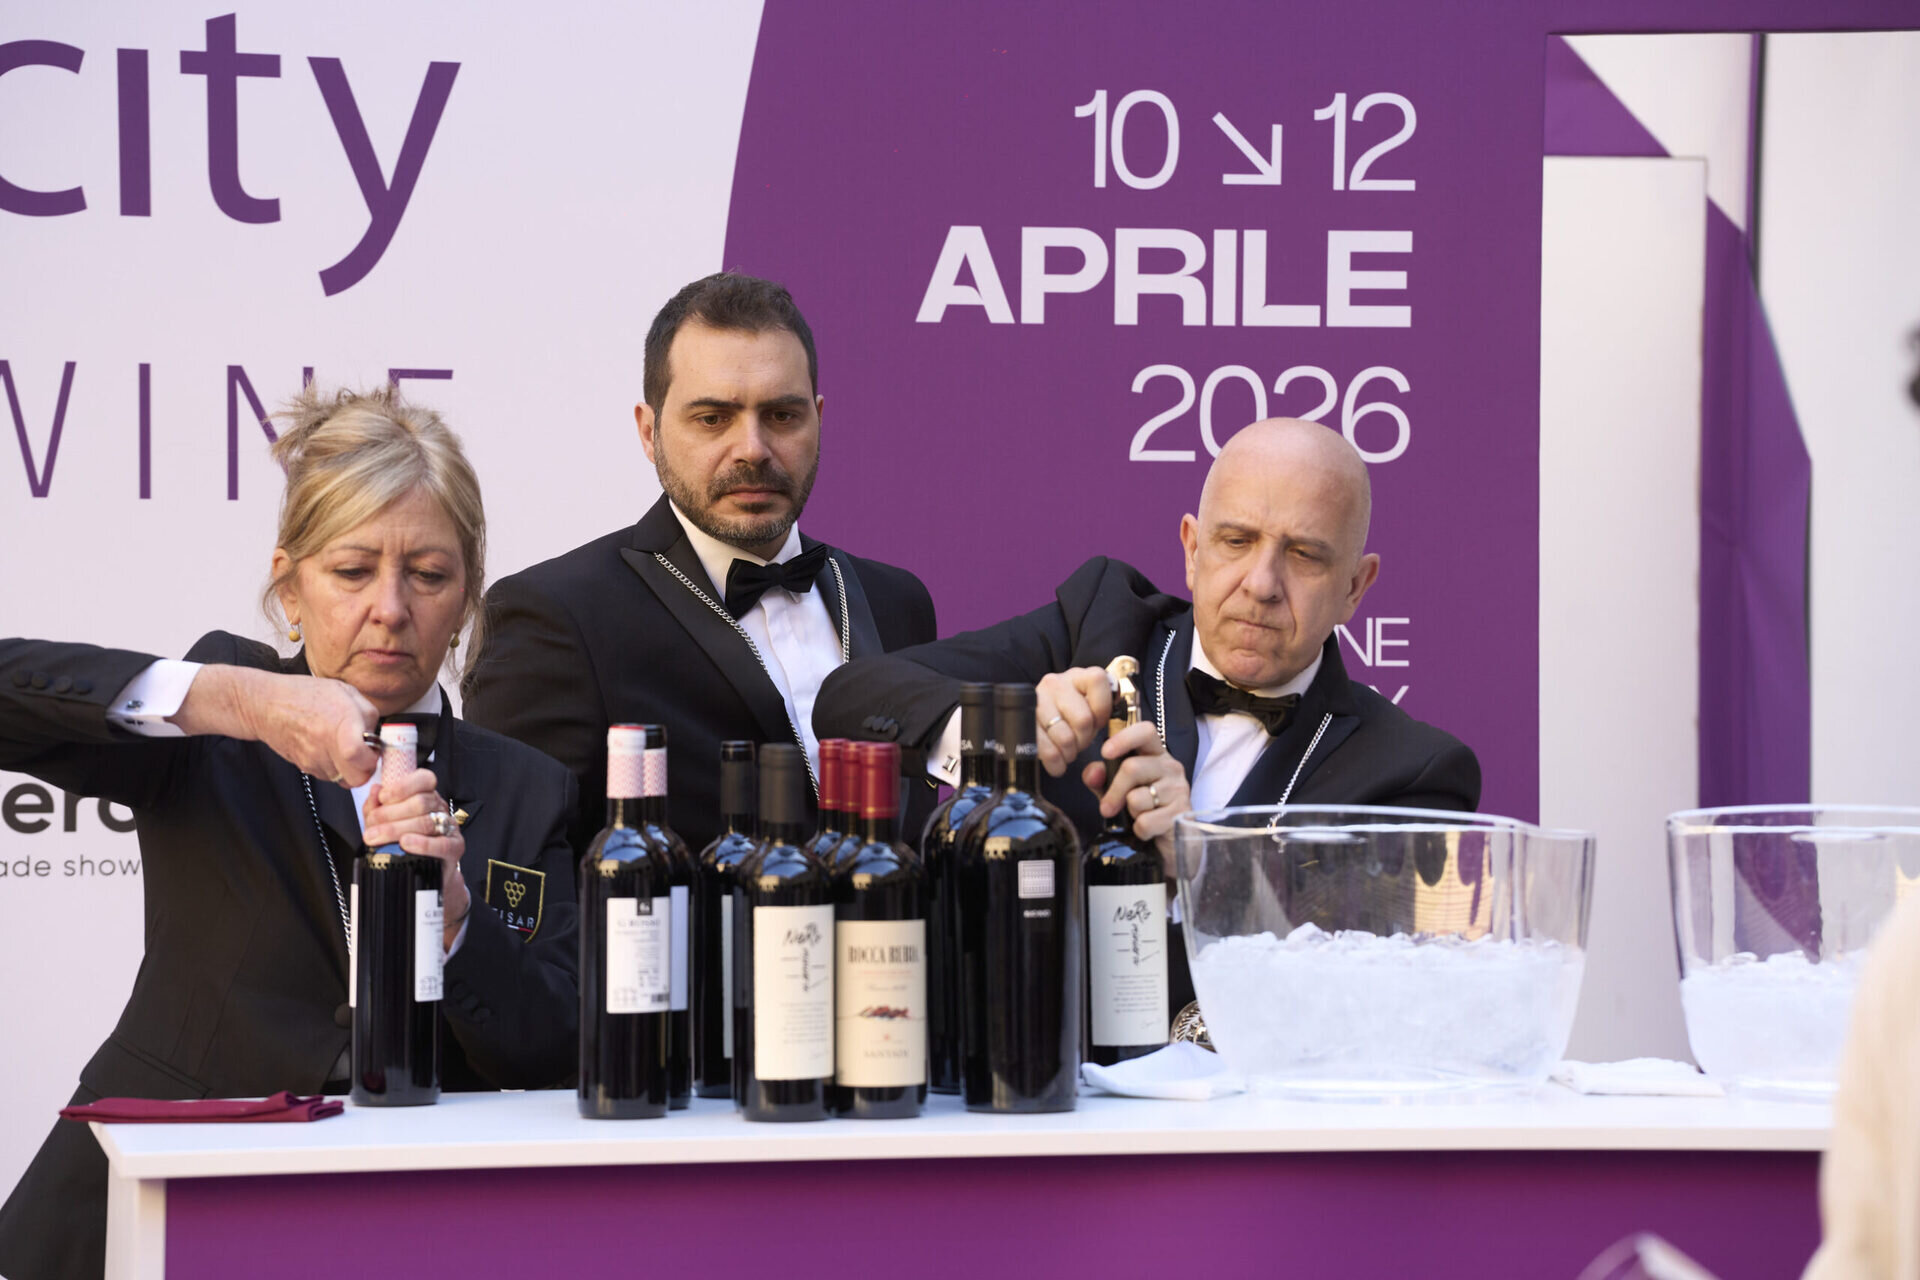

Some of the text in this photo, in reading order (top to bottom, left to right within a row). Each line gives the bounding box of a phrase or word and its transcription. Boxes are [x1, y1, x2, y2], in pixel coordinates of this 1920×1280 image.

[0, 13, 461, 297] city
[1074, 90, 1418, 192] 10 12
[916, 225, 1413, 328] APRILE
[64, 854, 140, 877] show
[491, 908, 535, 929] ISAR
